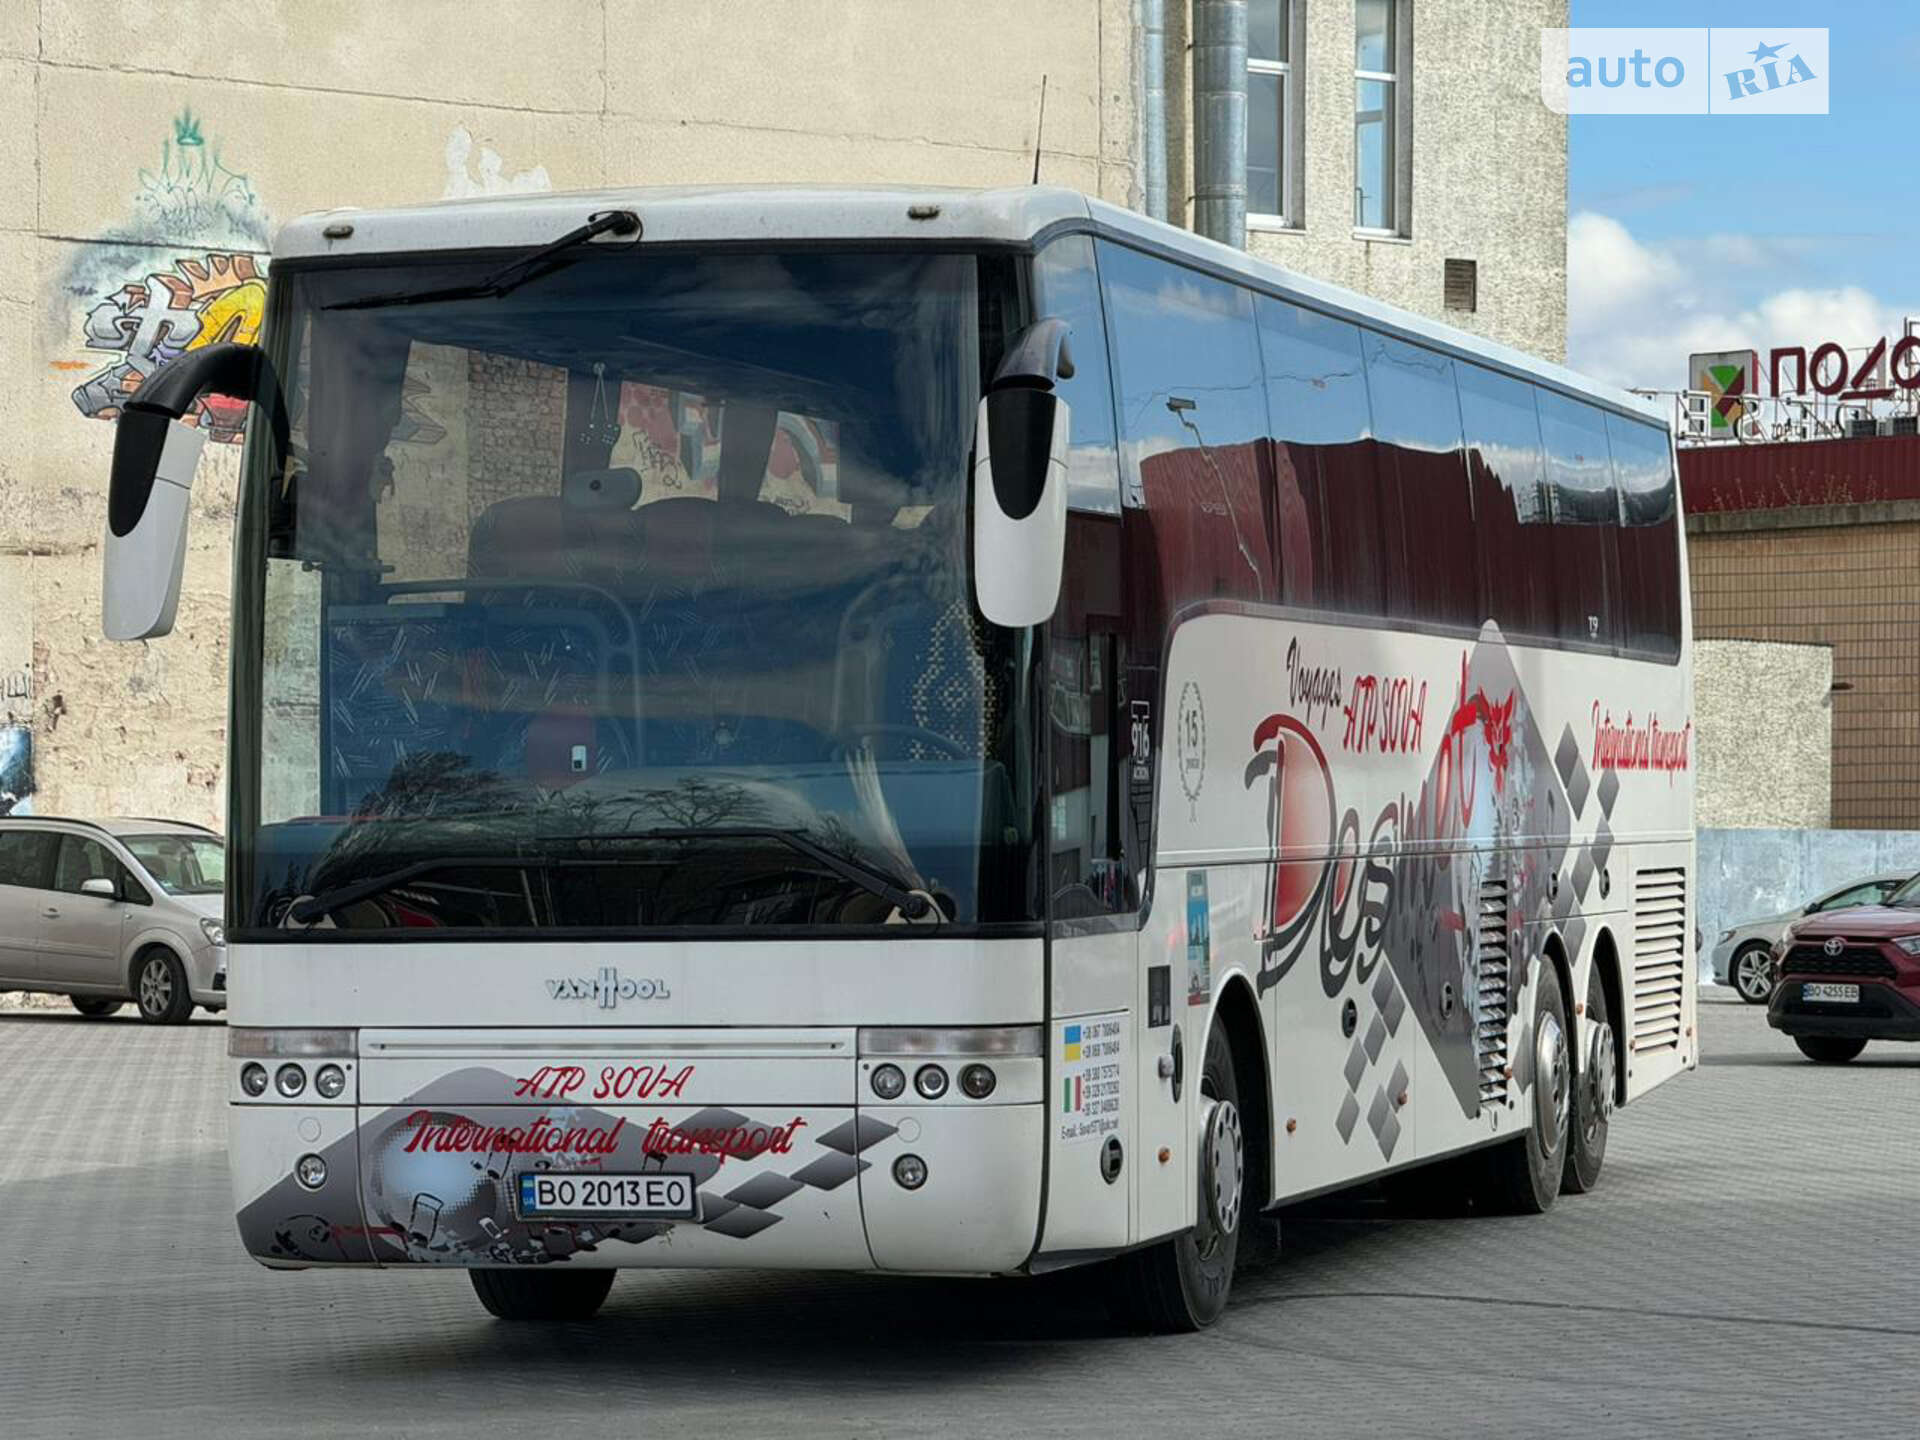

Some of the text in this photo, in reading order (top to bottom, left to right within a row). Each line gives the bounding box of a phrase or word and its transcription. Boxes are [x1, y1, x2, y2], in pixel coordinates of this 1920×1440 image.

[1286, 635, 1427, 754] Voyages ATP SOVA
[1184, 709, 1198, 748] 15
[514, 1064, 695, 1099] ATP SOVA
[404, 1108, 807, 1165] International transport
[538, 1181, 576, 1206] BO
[582, 1180, 641, 1206] 2013
